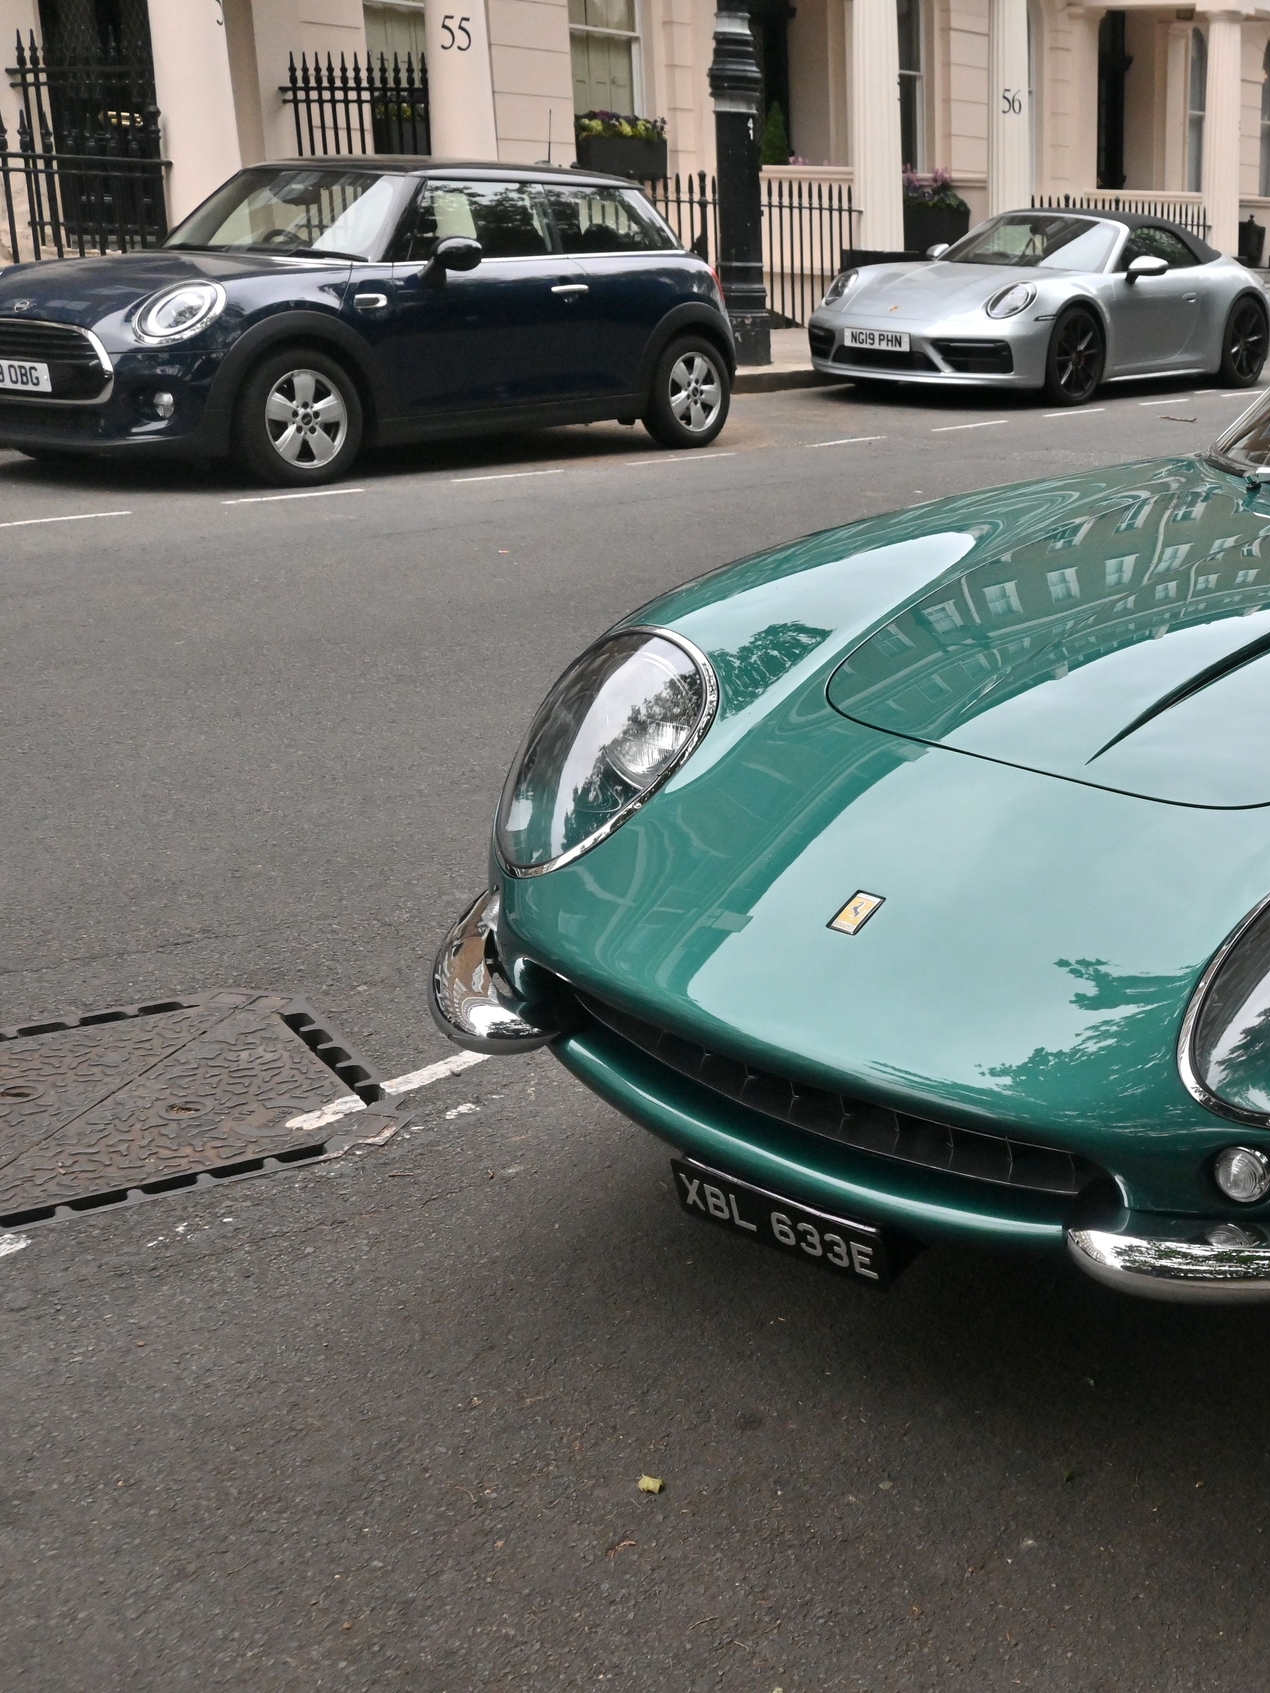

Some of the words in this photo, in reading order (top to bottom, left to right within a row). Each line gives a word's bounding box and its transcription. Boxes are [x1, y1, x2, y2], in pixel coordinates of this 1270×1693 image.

[441, 15, 471, 51] 55
[1002, 89, 1022, 114] 56
[851, 331, 876, 346] NG19
[878, 333, 902, 348] PHN
[8, 364, 40, 386] OBG
[679, 1173, 757, 1232] XBL
[771, 1212, 879, 1280] 633E
